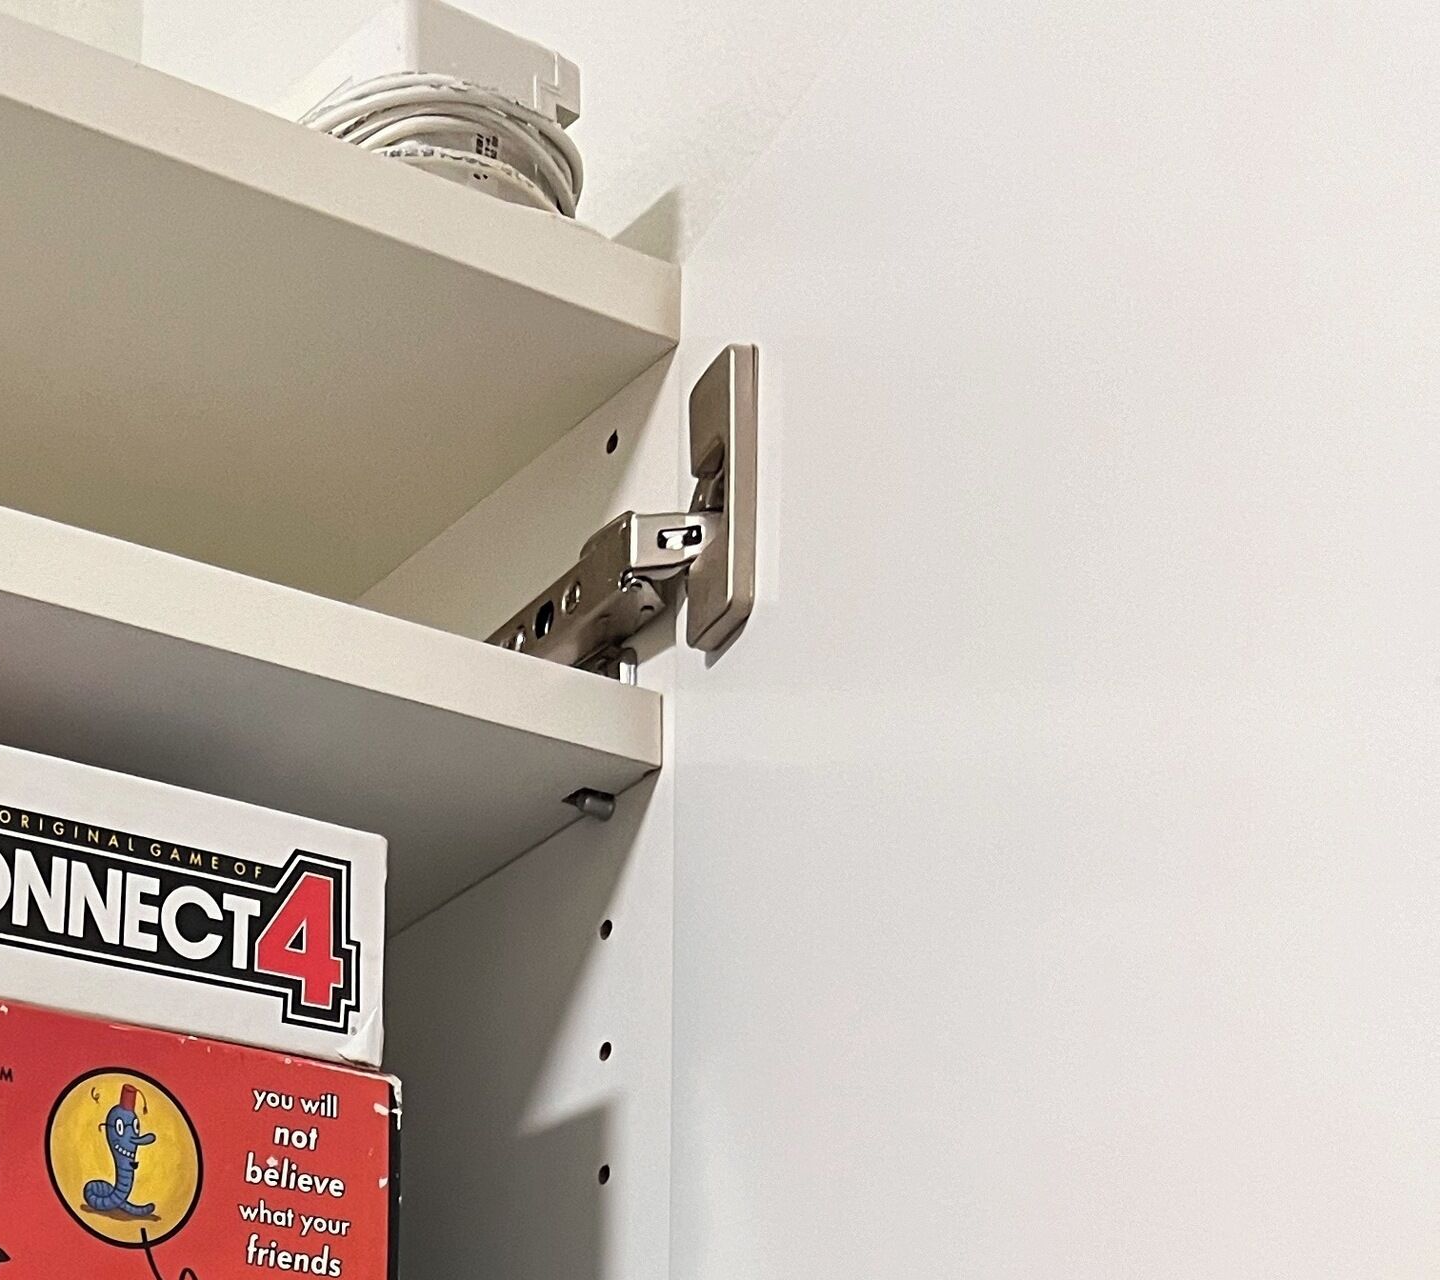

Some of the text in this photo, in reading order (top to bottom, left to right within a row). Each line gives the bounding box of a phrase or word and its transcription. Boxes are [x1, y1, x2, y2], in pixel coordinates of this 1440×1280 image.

[150, 843, 221, 872] GAME
[233, 861, 264, 880] OF
[251, 1088, 339, 1119] you will
[273, 1126, 319, 1151] not
[244, 1151, 346, 1198] believe
[238, 1198, 351, 1237] what your
[246, 1233, 342, 1278] friends
